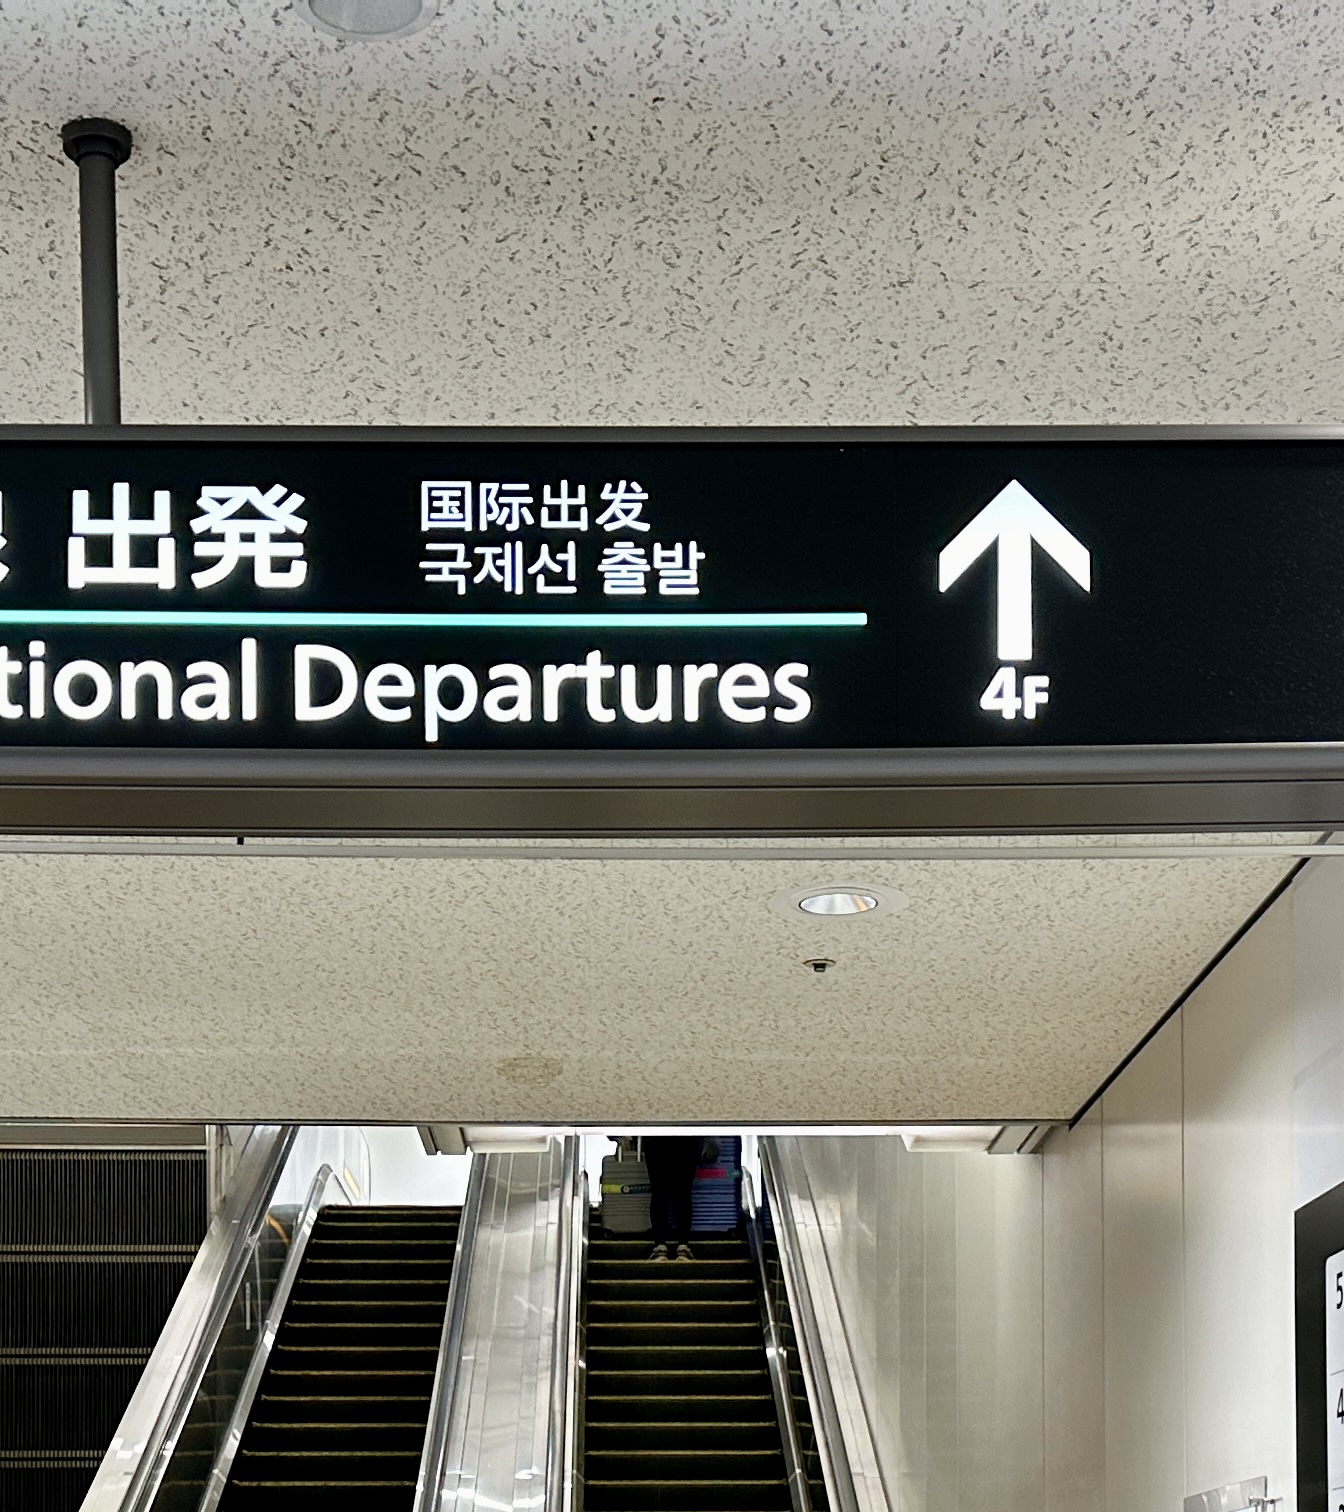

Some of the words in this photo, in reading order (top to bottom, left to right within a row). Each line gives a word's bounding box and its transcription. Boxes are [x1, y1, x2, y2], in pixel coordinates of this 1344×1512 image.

[420, 480, 651, 532] 国际出发
[66, 482, 310, 590] 出発
[419, 541, 578, 595] 국제선
[597, 541, 706, 595] 출발
[294, 642, 812, 741] Departures
[979, 673, 1050, 720] 4F
